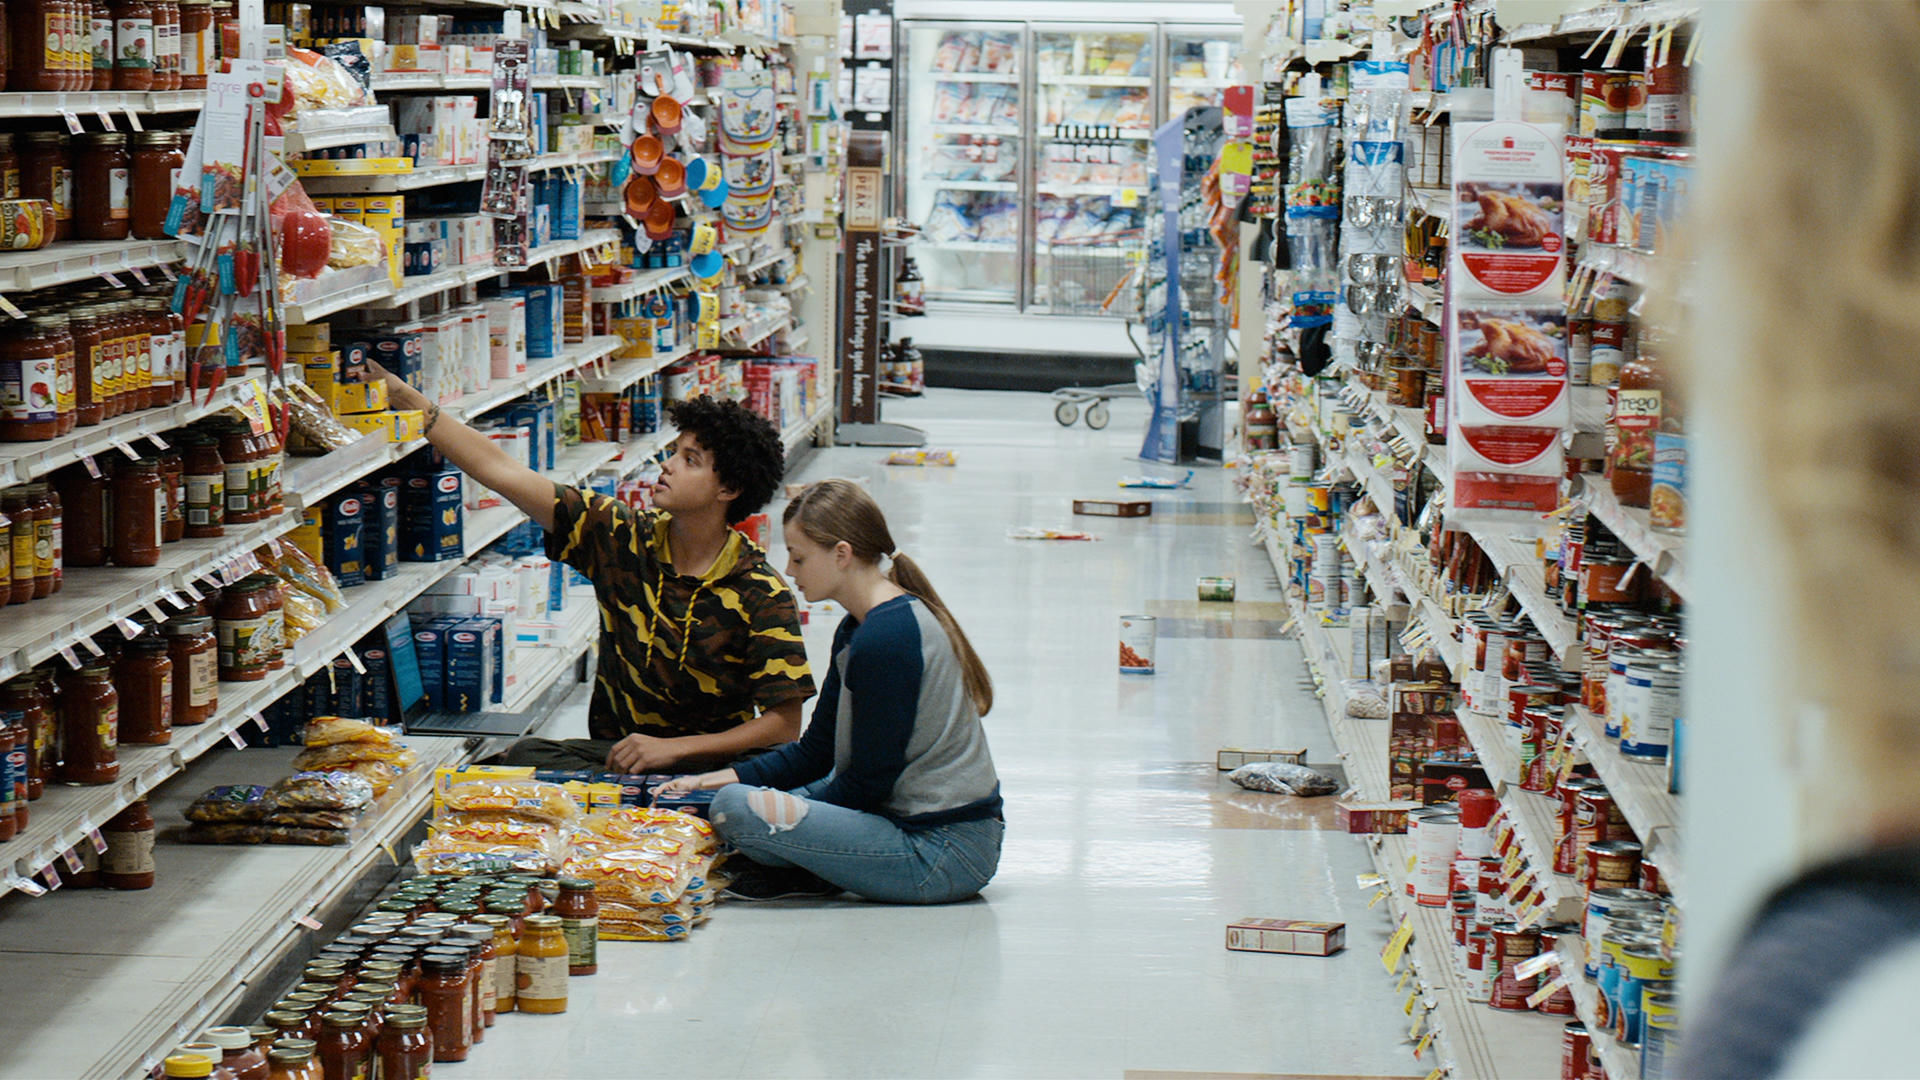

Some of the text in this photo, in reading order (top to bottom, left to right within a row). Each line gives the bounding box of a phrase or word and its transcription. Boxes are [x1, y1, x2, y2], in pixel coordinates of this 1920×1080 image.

[855, 176, 866, 209] PEAK
[856, 239, 874, 261] The
[855, 290, 873, 313] that
[848, 314, 870, 349] brings
[848, 350, 864, 372] you
[1479, 904, 1505, 914] Tomat
